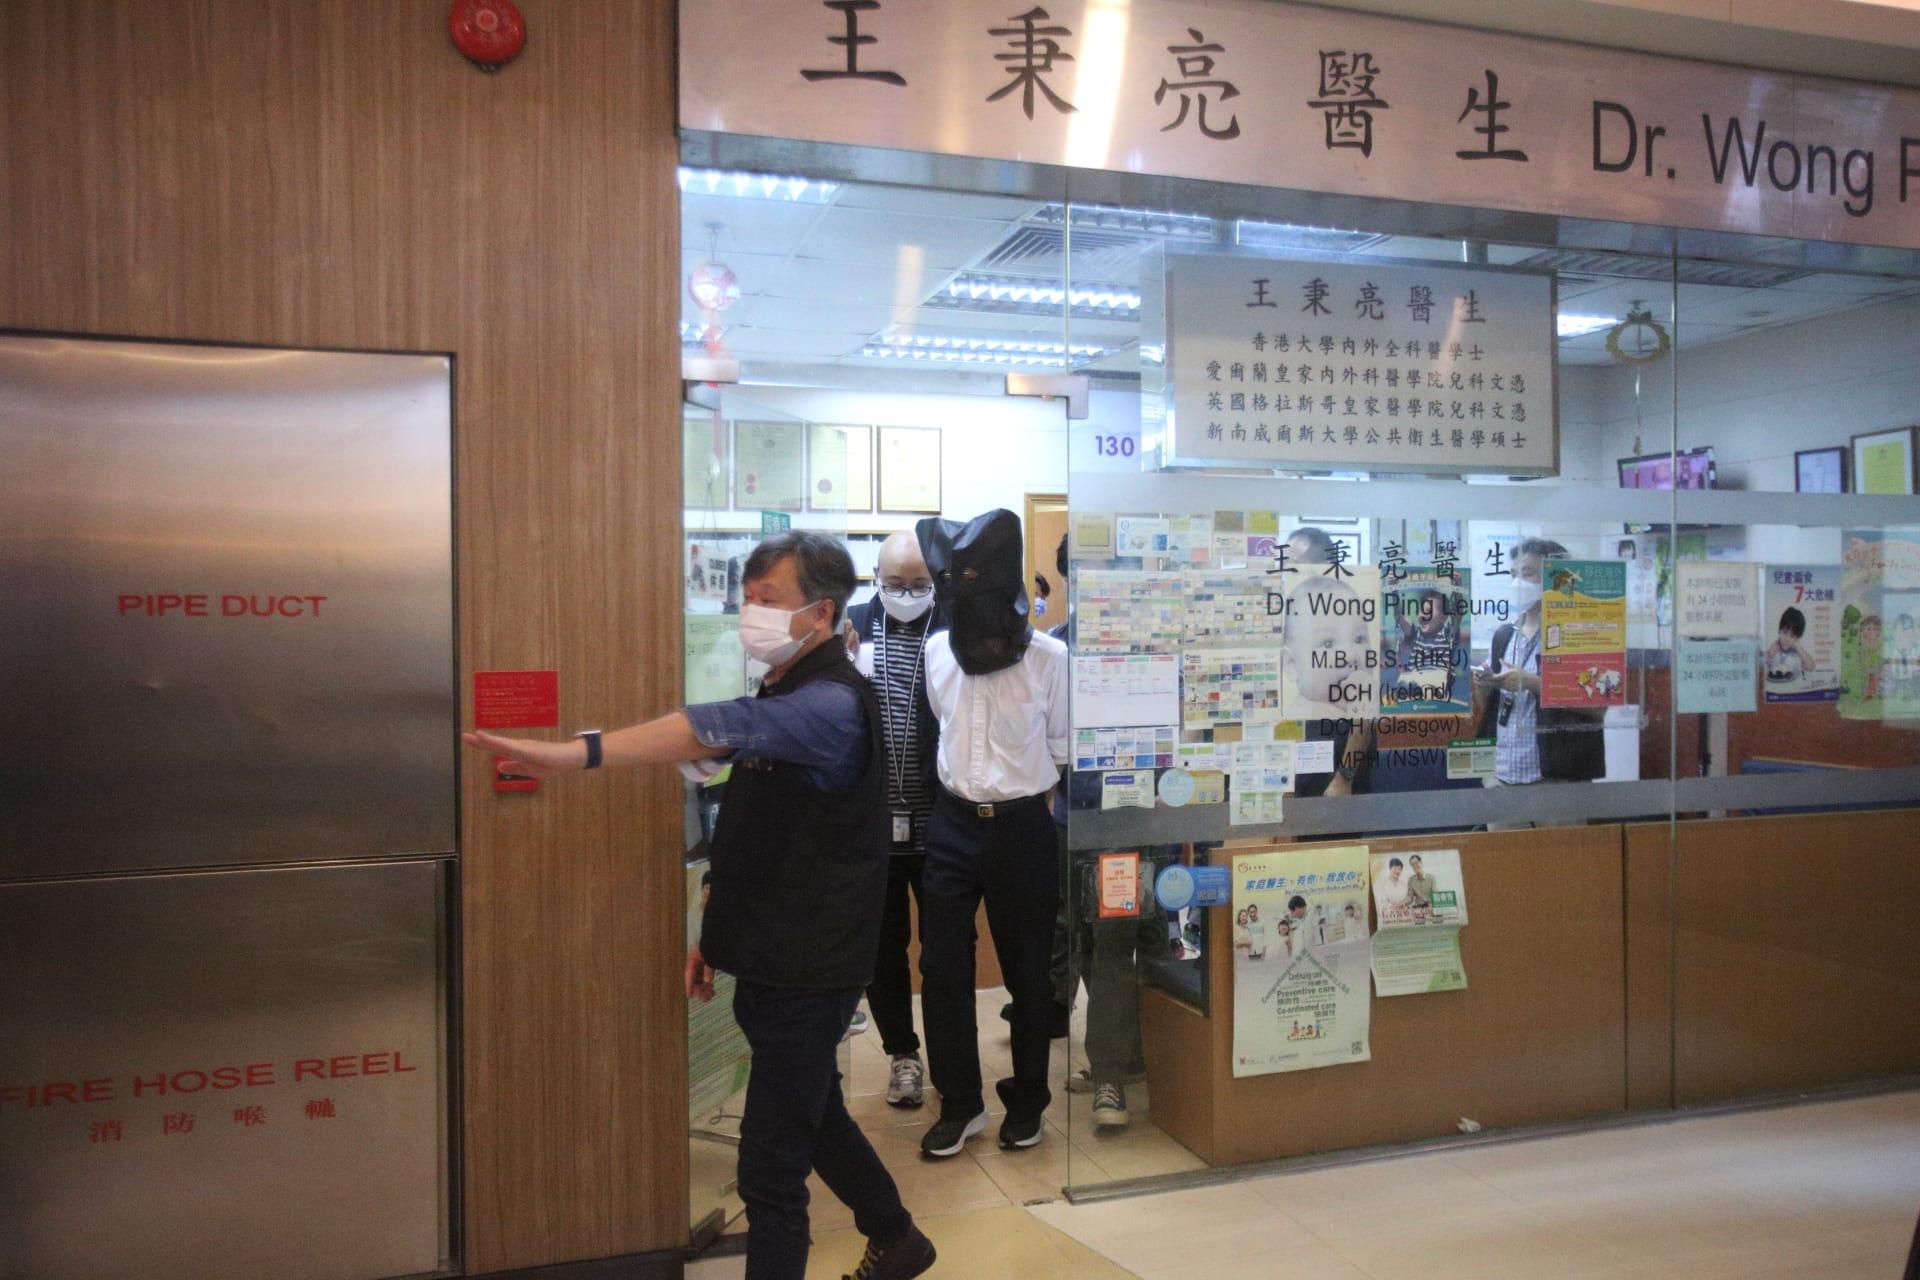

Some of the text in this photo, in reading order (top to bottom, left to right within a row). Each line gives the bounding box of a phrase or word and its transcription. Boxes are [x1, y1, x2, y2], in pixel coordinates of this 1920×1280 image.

[799, 0, 1530, 161] 王秉亮醫生
[1592, 100, 1676, 180] Dr.
[1702, 114, 1876, 218] Wong
[1245, 276, 1487, 325] 王秉亮醫生
[1095, 435, 1135, 457] 130
[1265, 539, 1512, 580] 王秉亮醫生
[118, 594, 329, 617] PIPE DUCT
[1266, 592, 1298, 616] Dr.
[1307, 592, 1376, 622] Wong
[1384, 592, 1434, 622] Ping
[1442, 593, 1509, 622] Leung
[1311, 650, 1359, 671] M.B.,
[1414, 649, 1468, 671] (HKU)
[1328, 683, 1453, 705] DCH (Ireland)
[1319, 715, 1461, 738] DCH (Glasgow)
[1336, 748, 1447, 770] MPH (NSW)
[1276, 987, 1317, 998] Preventive
[1318, 985, 1336, 993] care
[1320, 1002, 1337, 1010] care
[132, 1062, 276, 1098] HOSE
[294, 1049, 418, 1082] REEL
